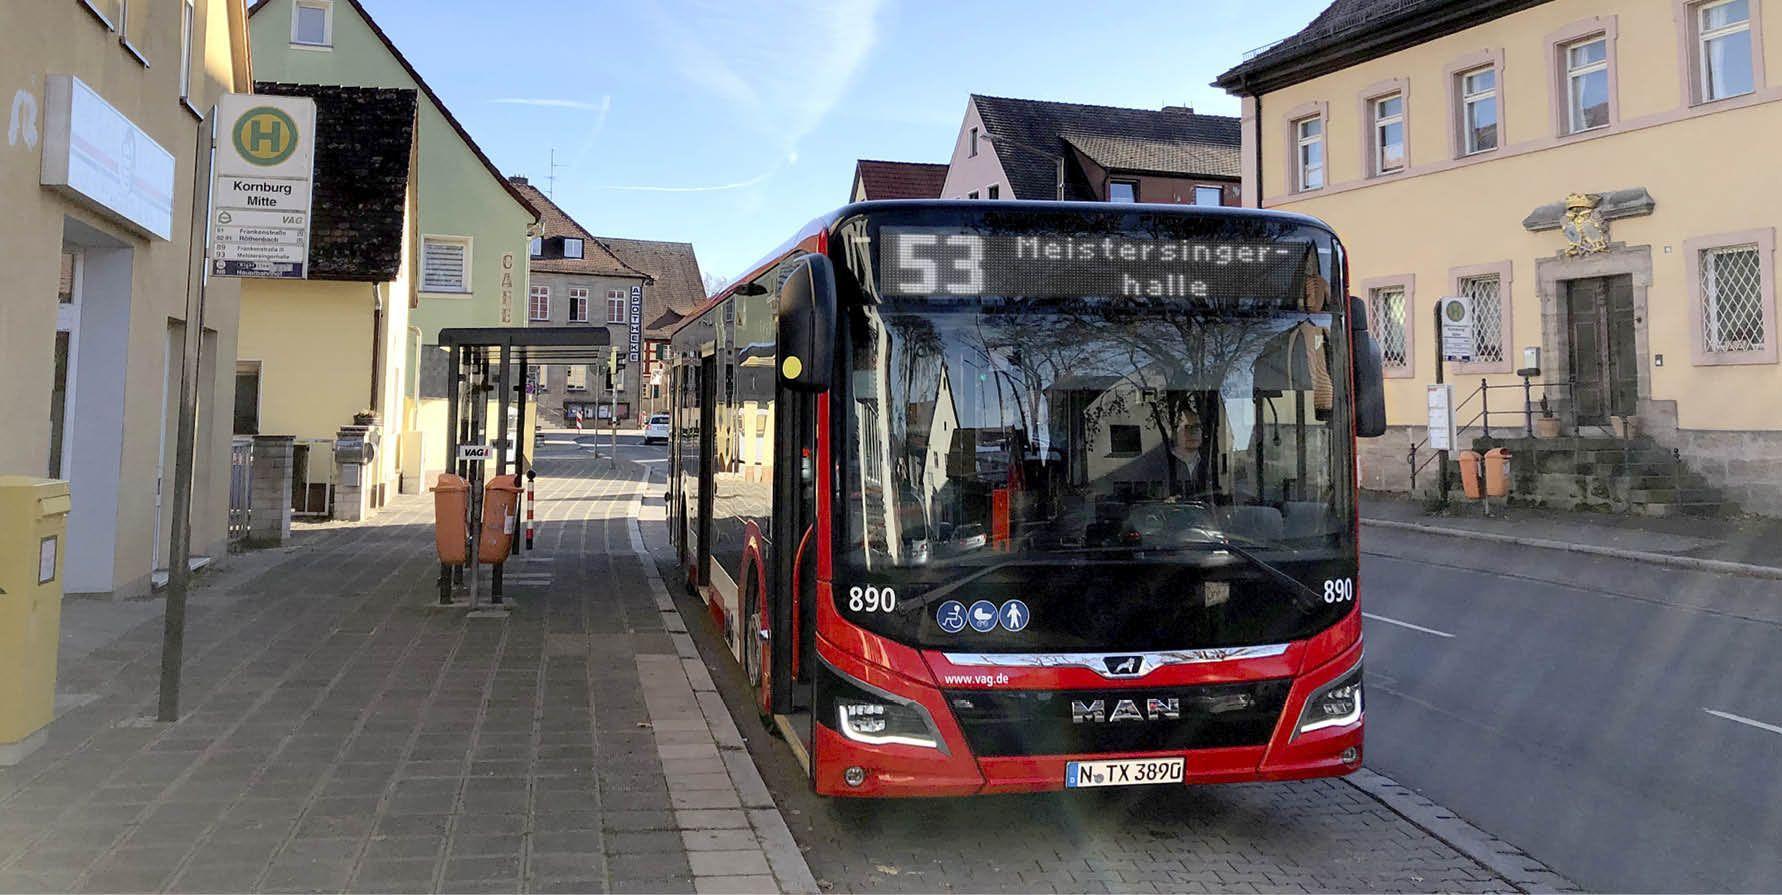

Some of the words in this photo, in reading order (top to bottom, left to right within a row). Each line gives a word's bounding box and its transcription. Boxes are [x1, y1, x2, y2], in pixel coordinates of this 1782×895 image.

[250, 119, 281, 153] H
[233, 180, 292, 195] Kornburg
[247, 195, 277, 207] Mitte
[282, 216, 303, 225] VAG
[898, 234, 984, 294] 53
[1015, 235, 1289, 265] Meistersinger-
[1121, 273, 1208, 298] halle
[630, 286, 640, 362] APOTHEKE
[465, 448, 485, 457] VAG
[848, 585, 896, 613] 890
[1324, 577, 1353, 604] 890
[944, 673, 1010, 687] www.vag.de
[1070, 697, 1181, 725] MAN
[1080, 765, 1093, 784] N
[1106, 764, 1130, 783] TX
[1134, 761, 1182, 781] 3890
